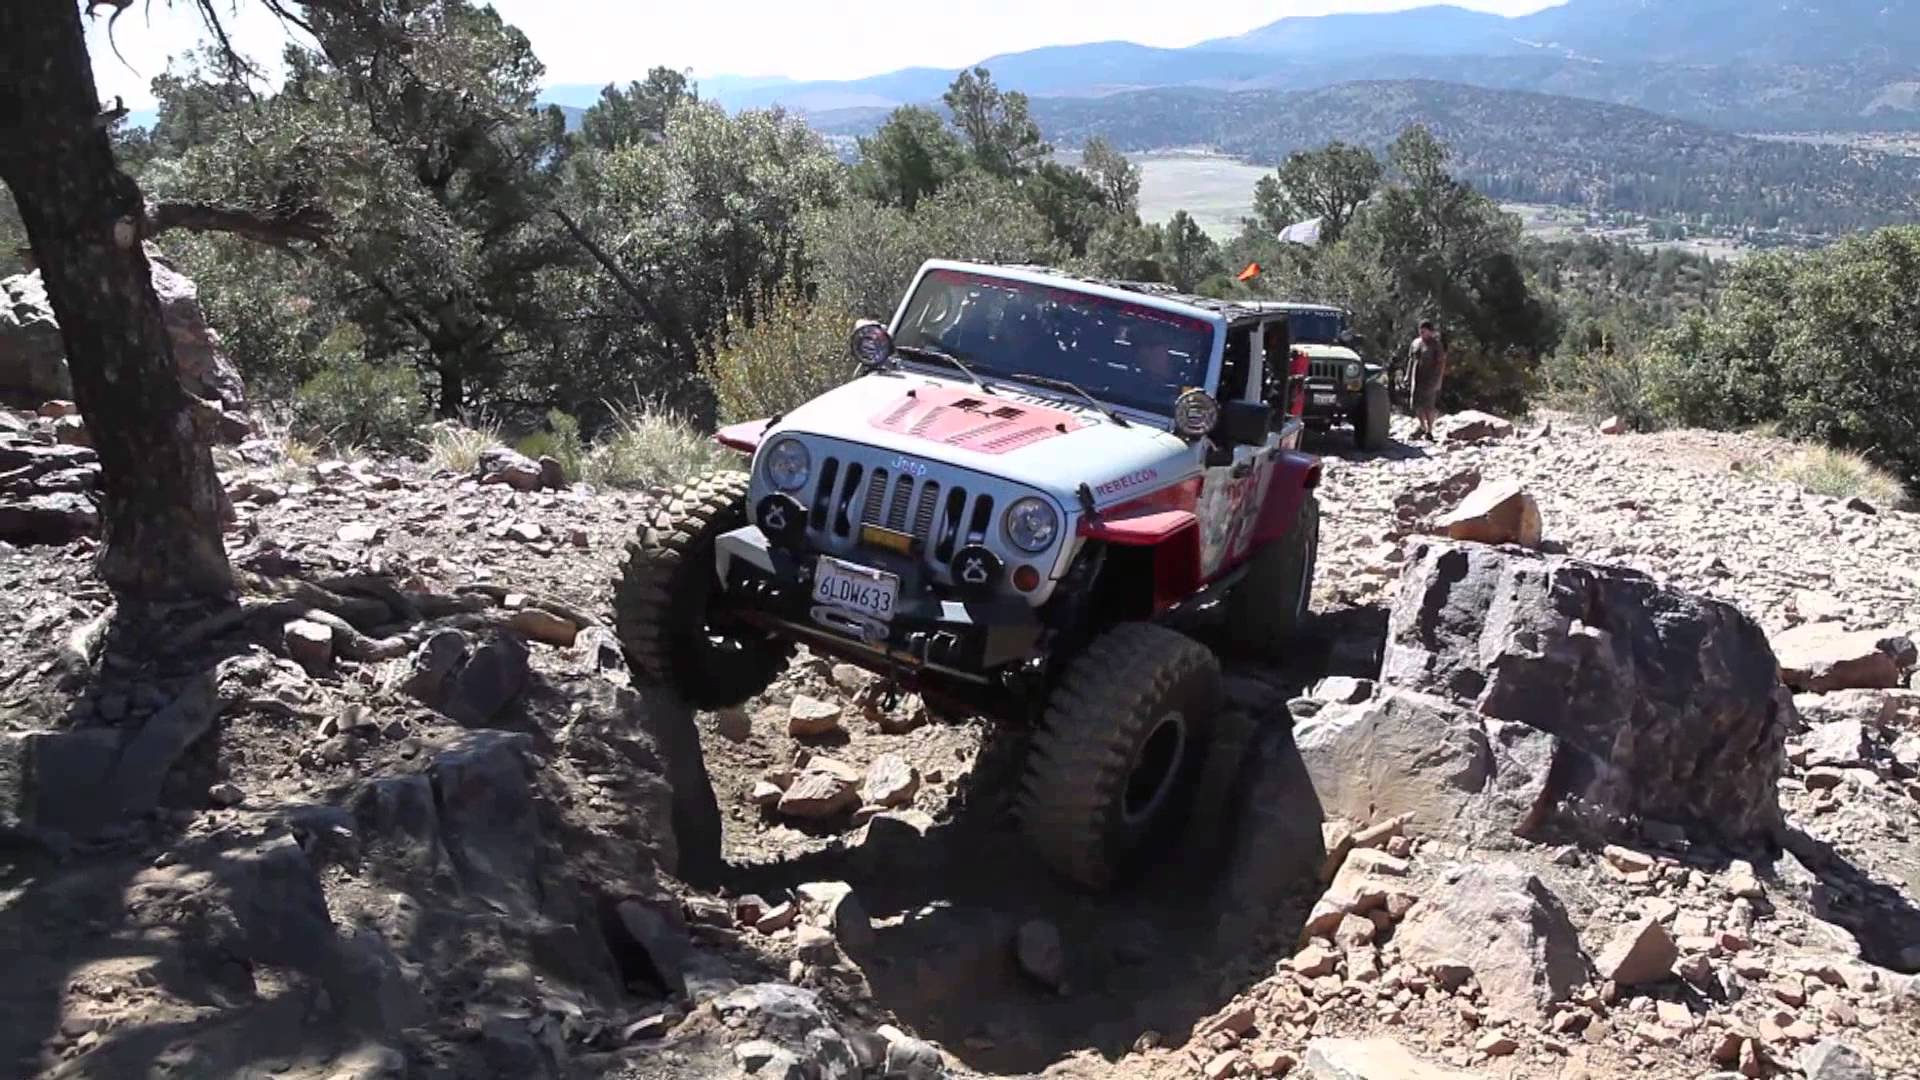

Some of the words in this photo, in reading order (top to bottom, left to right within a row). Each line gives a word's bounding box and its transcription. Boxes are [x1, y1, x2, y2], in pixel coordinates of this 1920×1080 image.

[891, 455, 928, 477] Jeep
[1095, 468, 1158, 497] REBELCON
[820, 575, 892, 612] 6LDW633
